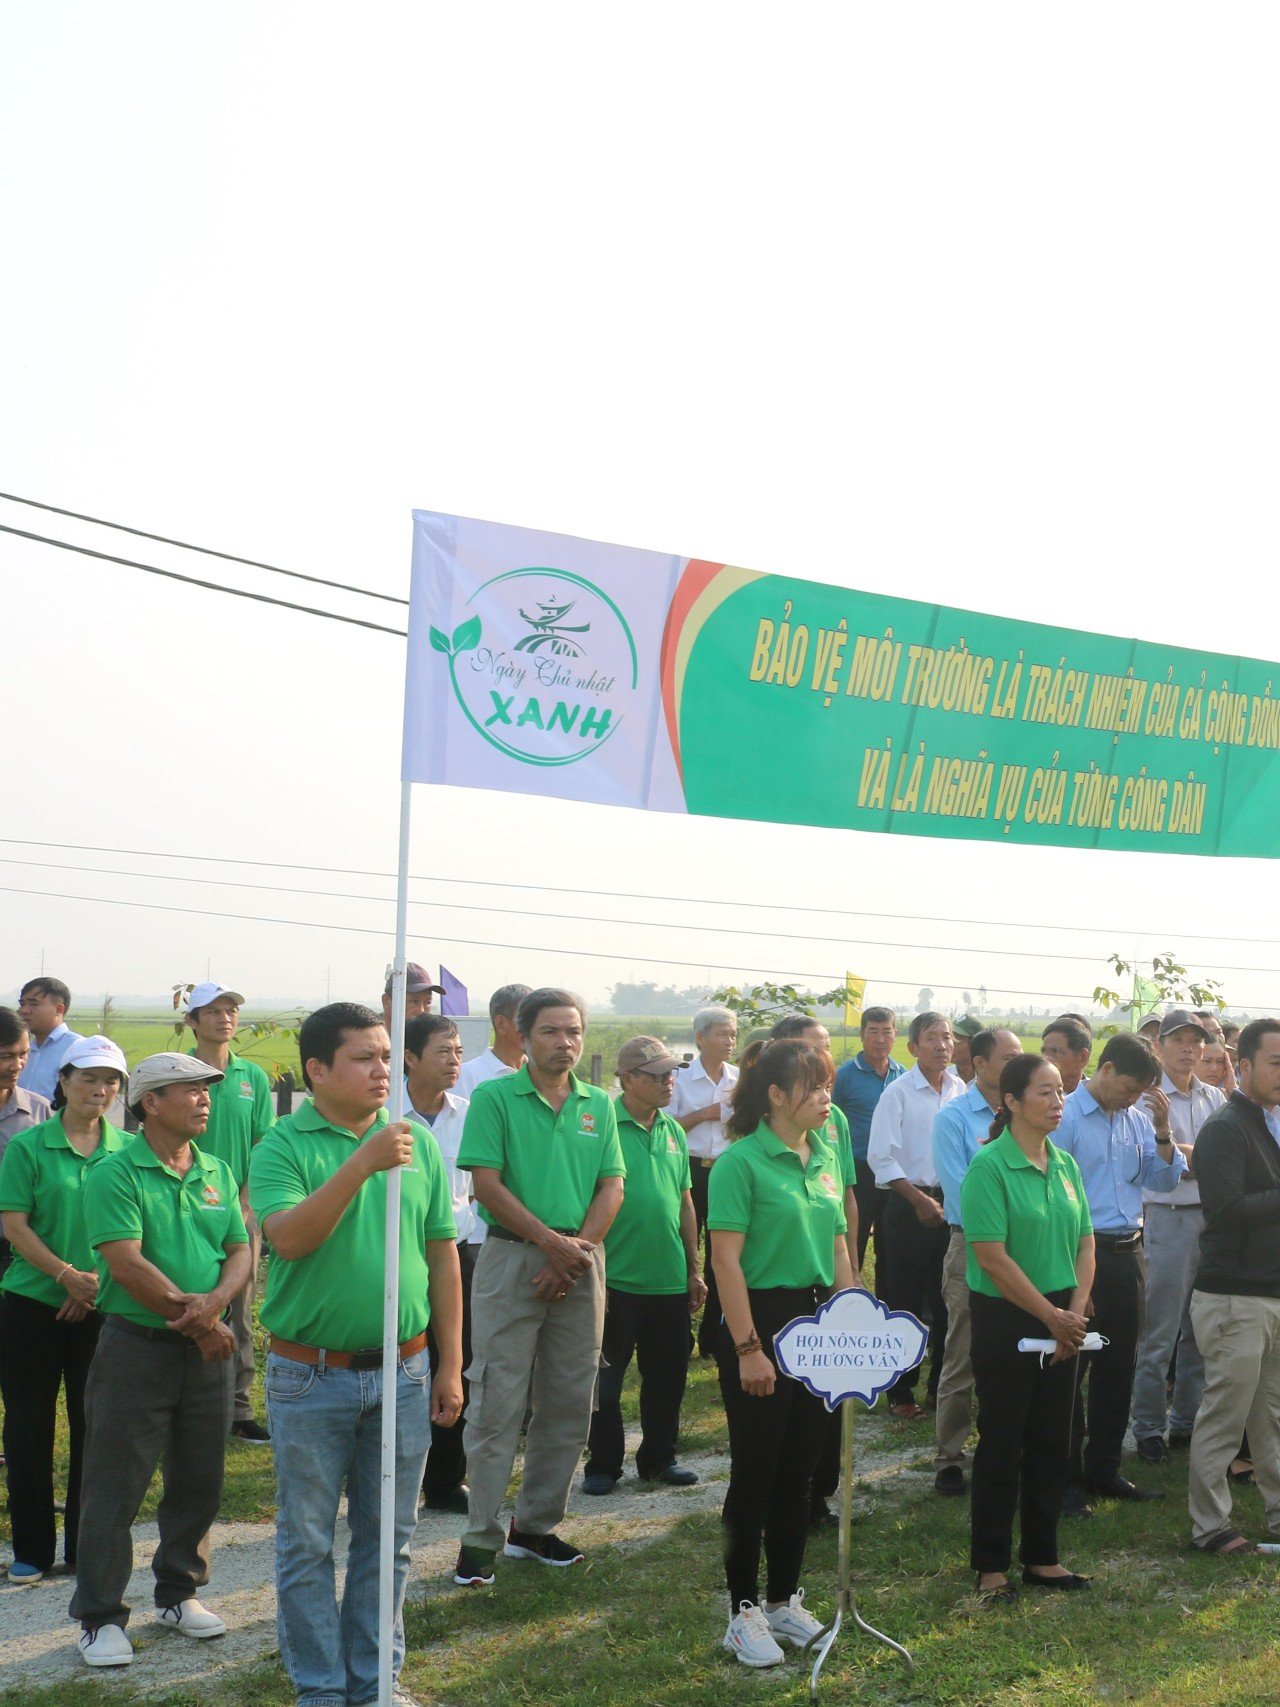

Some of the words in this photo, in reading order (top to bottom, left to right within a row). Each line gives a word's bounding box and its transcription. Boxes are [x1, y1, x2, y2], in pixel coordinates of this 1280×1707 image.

[470, 647, 527, 688] Ngày
[534, 655, 571, 688] Chủ
[575, 670, 616, 697] nhật
[749, 599, 809, 688] BẢO
[811, 617, 848, 707] VỆ
[846, 626, 902, 702] MÔI
[901, 637, 994, 715] TRƯỜNG
[990, 649, 1024, 719] LÀ
[1022, 655, 1089, 727] TRÁCH
[1084, 666, 1148, 745] NHIỆM
[1145, 664, 1180, 738] CỦA
[1179, 670, 1206, 741] CẢ
[1204, 679, 1248, 756] CỘNG
[484, 690, 613, 739] XANH
[857, 737, 892, 810] VÀ
[891, 741, 925, 813] LÀ
[922, 748, 995, 819] NGHĨA
[993, 764, 1027, 834] VỤ
[1024, 749, 1068, 826] CỦA
[1067, 760, 1119, 829] TỪNG
[1118, 766, 1168, 832] CÔNG
[1167, 770, 1207, 835] DÂN
[796, 1333, 823, 1351] HỘI
[827, 1332, 868, 1348] NÔNG
[872, 1333, 904, 1349] DÂN
[796, 1353, 807, 1367] P.
[812, 1352, 865, 1367] HƯƠNG
[868, 1352, 900, 1368] VĂN
